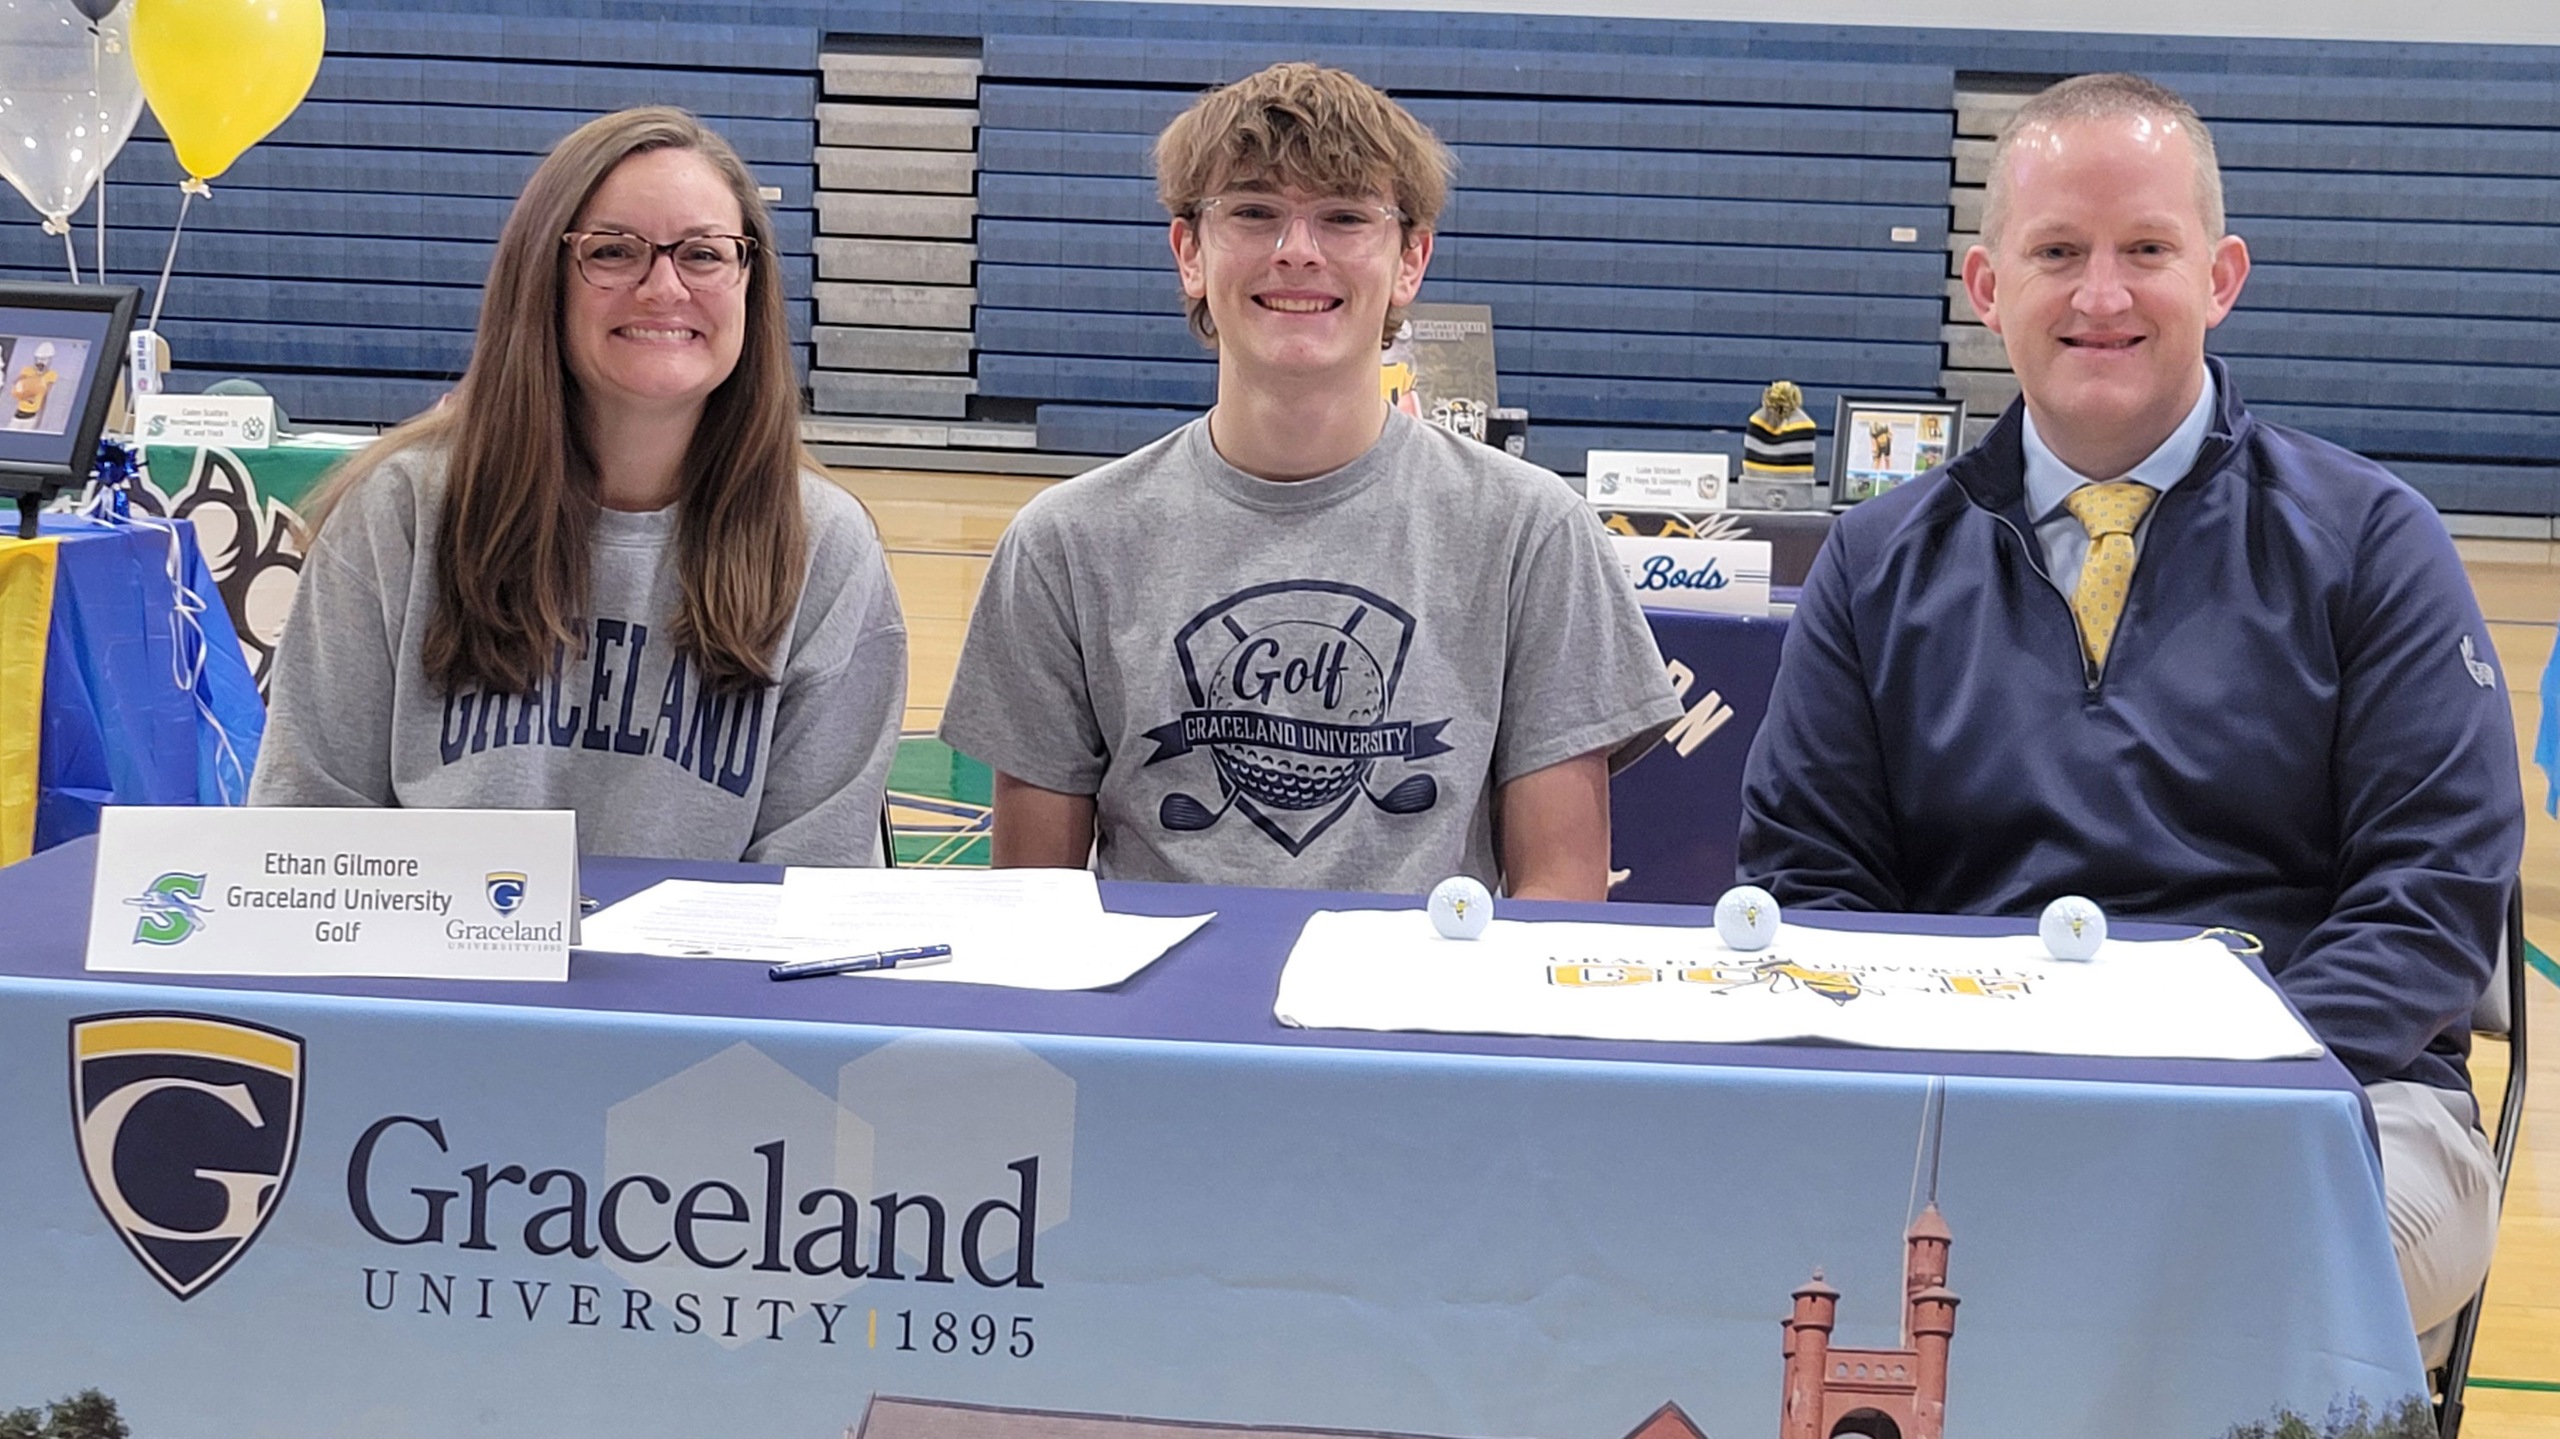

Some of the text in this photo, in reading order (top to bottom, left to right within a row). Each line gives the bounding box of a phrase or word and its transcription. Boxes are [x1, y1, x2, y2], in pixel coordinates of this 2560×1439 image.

[1634, 555, 1730, 591] Bods
[1232, 637, 1349, 710] Golf
[1185, 714, 1409, 755] GRACELAND UNIVERSITY
[264, 852, 419, 877] Ethan Gilmore
[226, 885, 453, 917] Graceland University
[315, 920, 362, 943] Golf
[445, 918, 563, 942] Graceland
[447, 942, 531, 952] UNIVERSITY
[83, 1076, 281, 1242] G
[346, 1114, 1045, 1290] Graceland
[361, 1267, 1036, 1359] UNIVERSITY 1895
